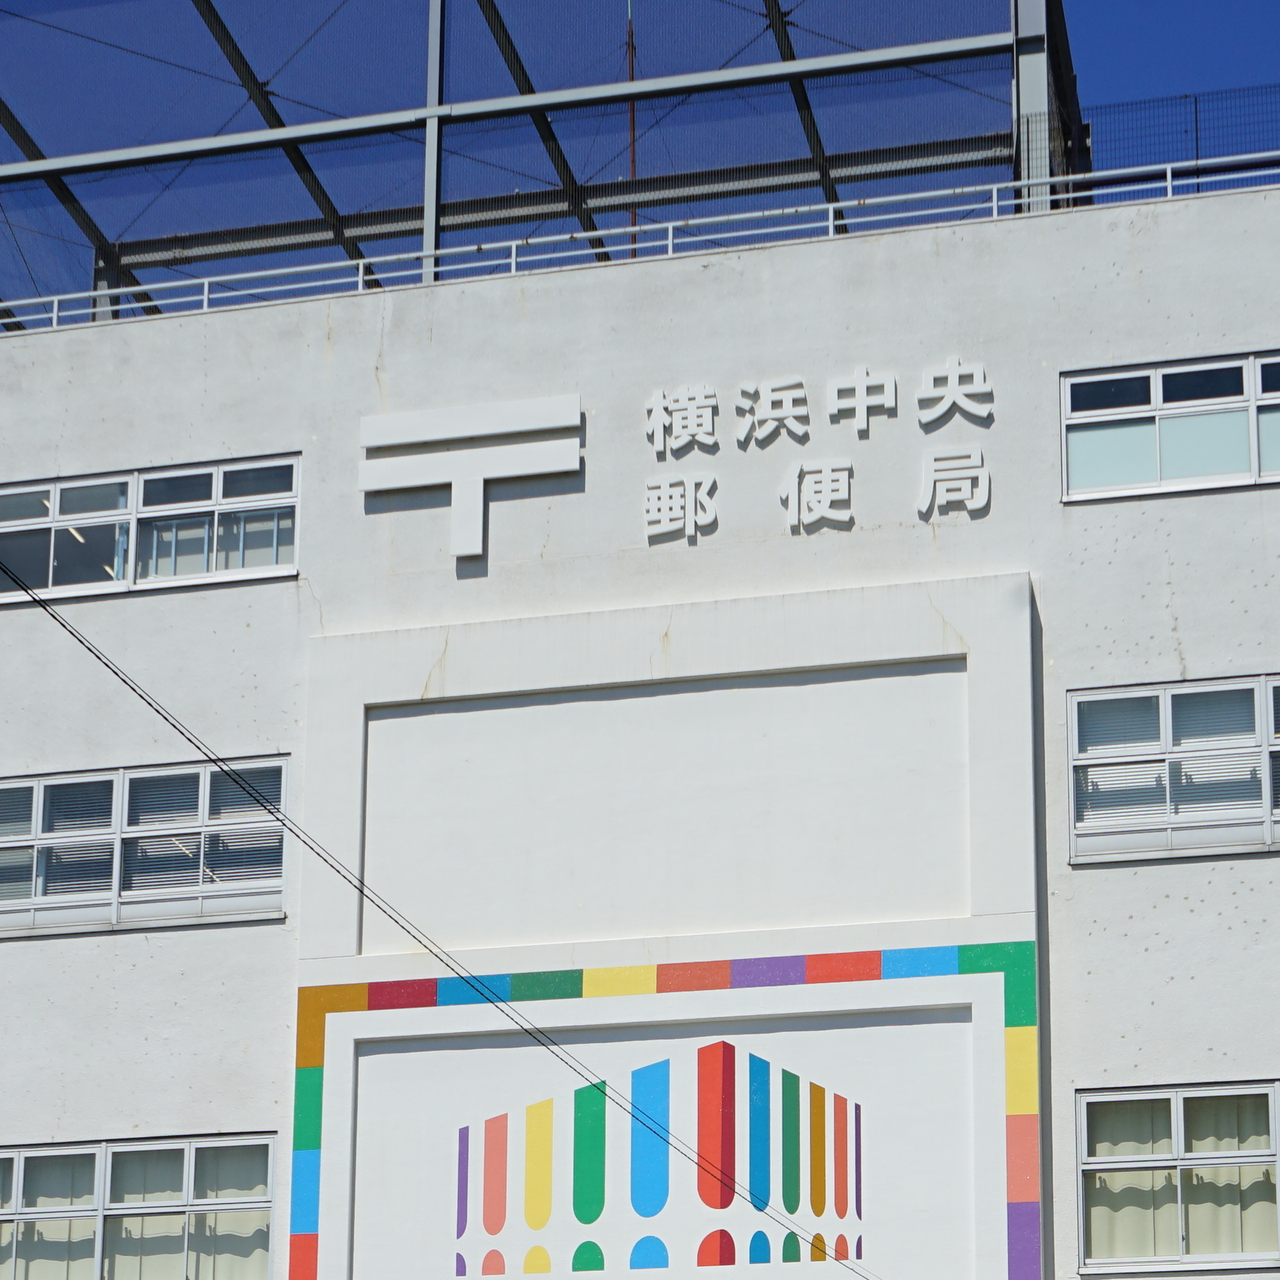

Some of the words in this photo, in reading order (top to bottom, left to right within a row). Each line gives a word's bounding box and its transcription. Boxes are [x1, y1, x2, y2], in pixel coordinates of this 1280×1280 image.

[644, 356, 995, 457] 横浜中央
[643, 447, 991, 545] 郵便局
